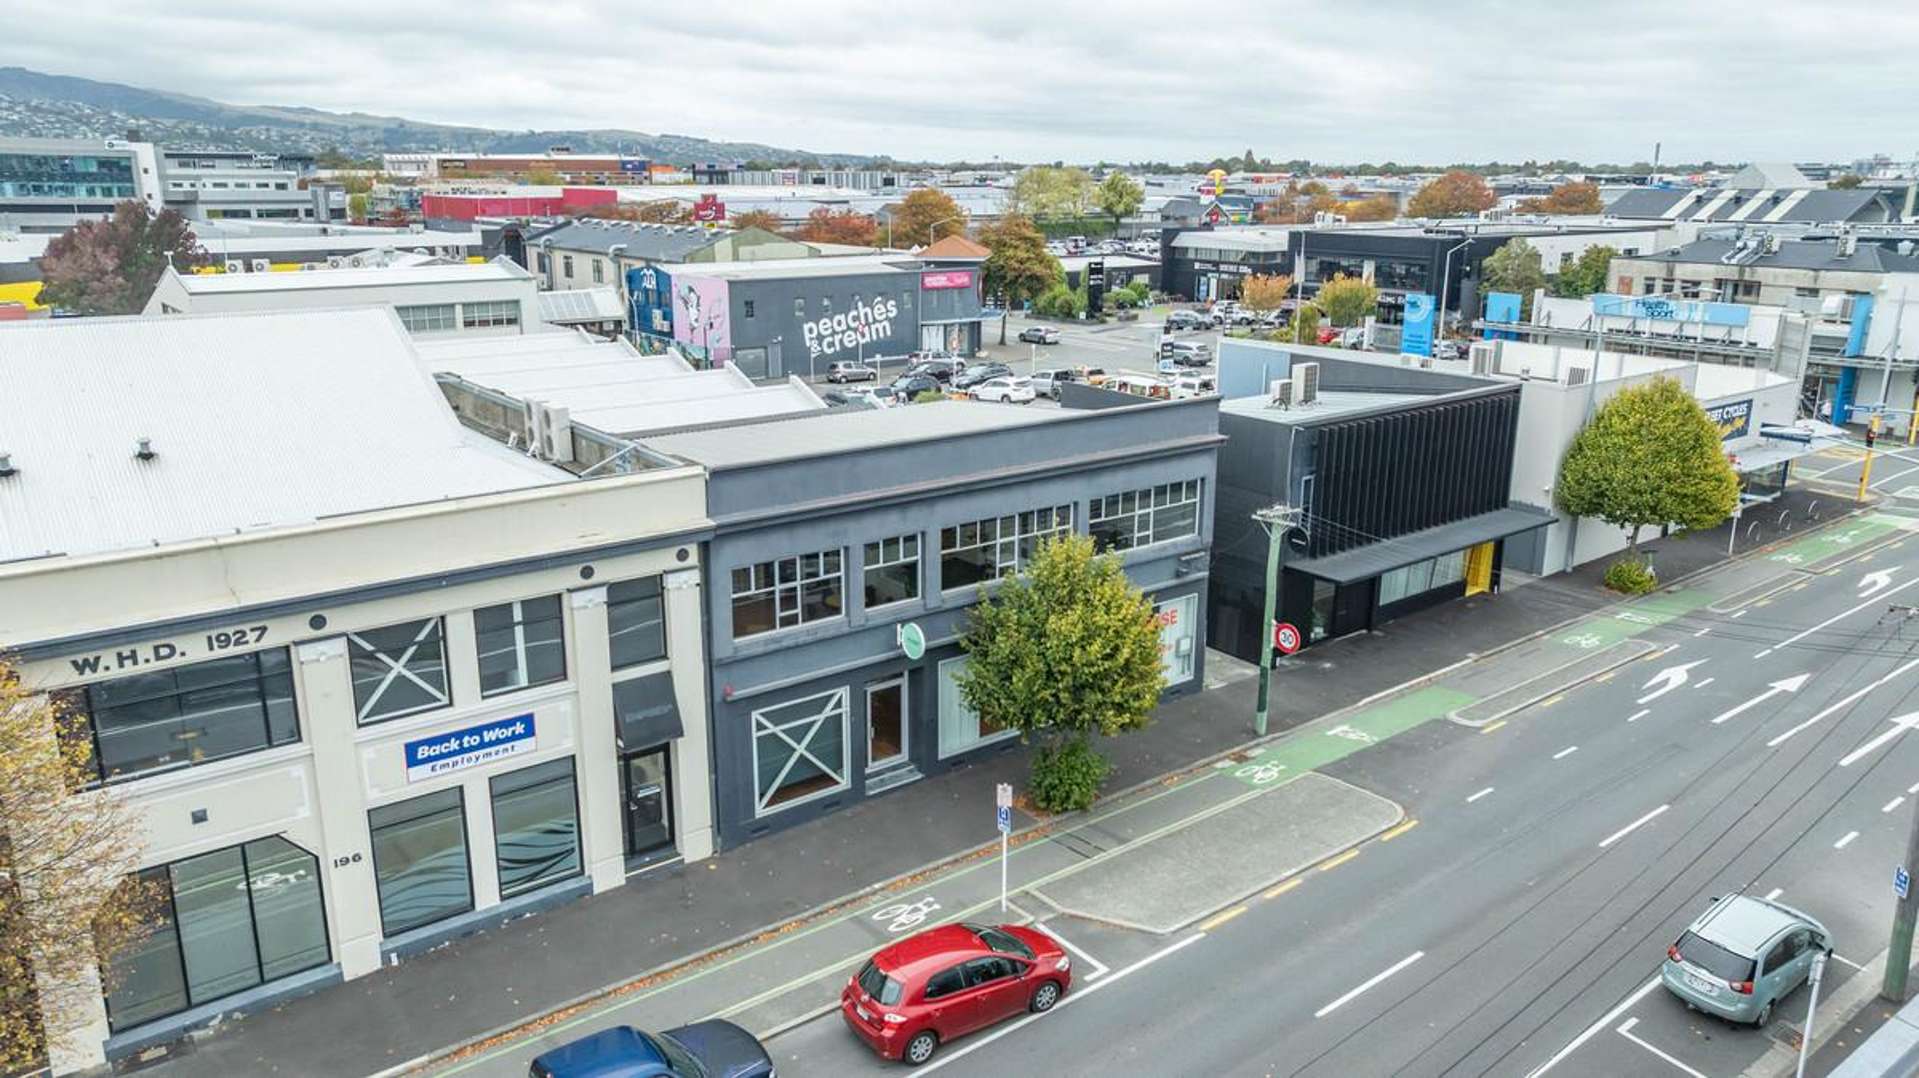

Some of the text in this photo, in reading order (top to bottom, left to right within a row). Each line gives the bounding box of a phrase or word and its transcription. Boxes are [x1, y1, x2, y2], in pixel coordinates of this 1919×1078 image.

[70, 625, 269, 676] W.H.D. 1927
[1281, 631, 1295, 645] 30
[417, 721, 526, 760] Back to Work
[430, 744, 516, 771] Employment
[334, 853, 362, 869] 196
